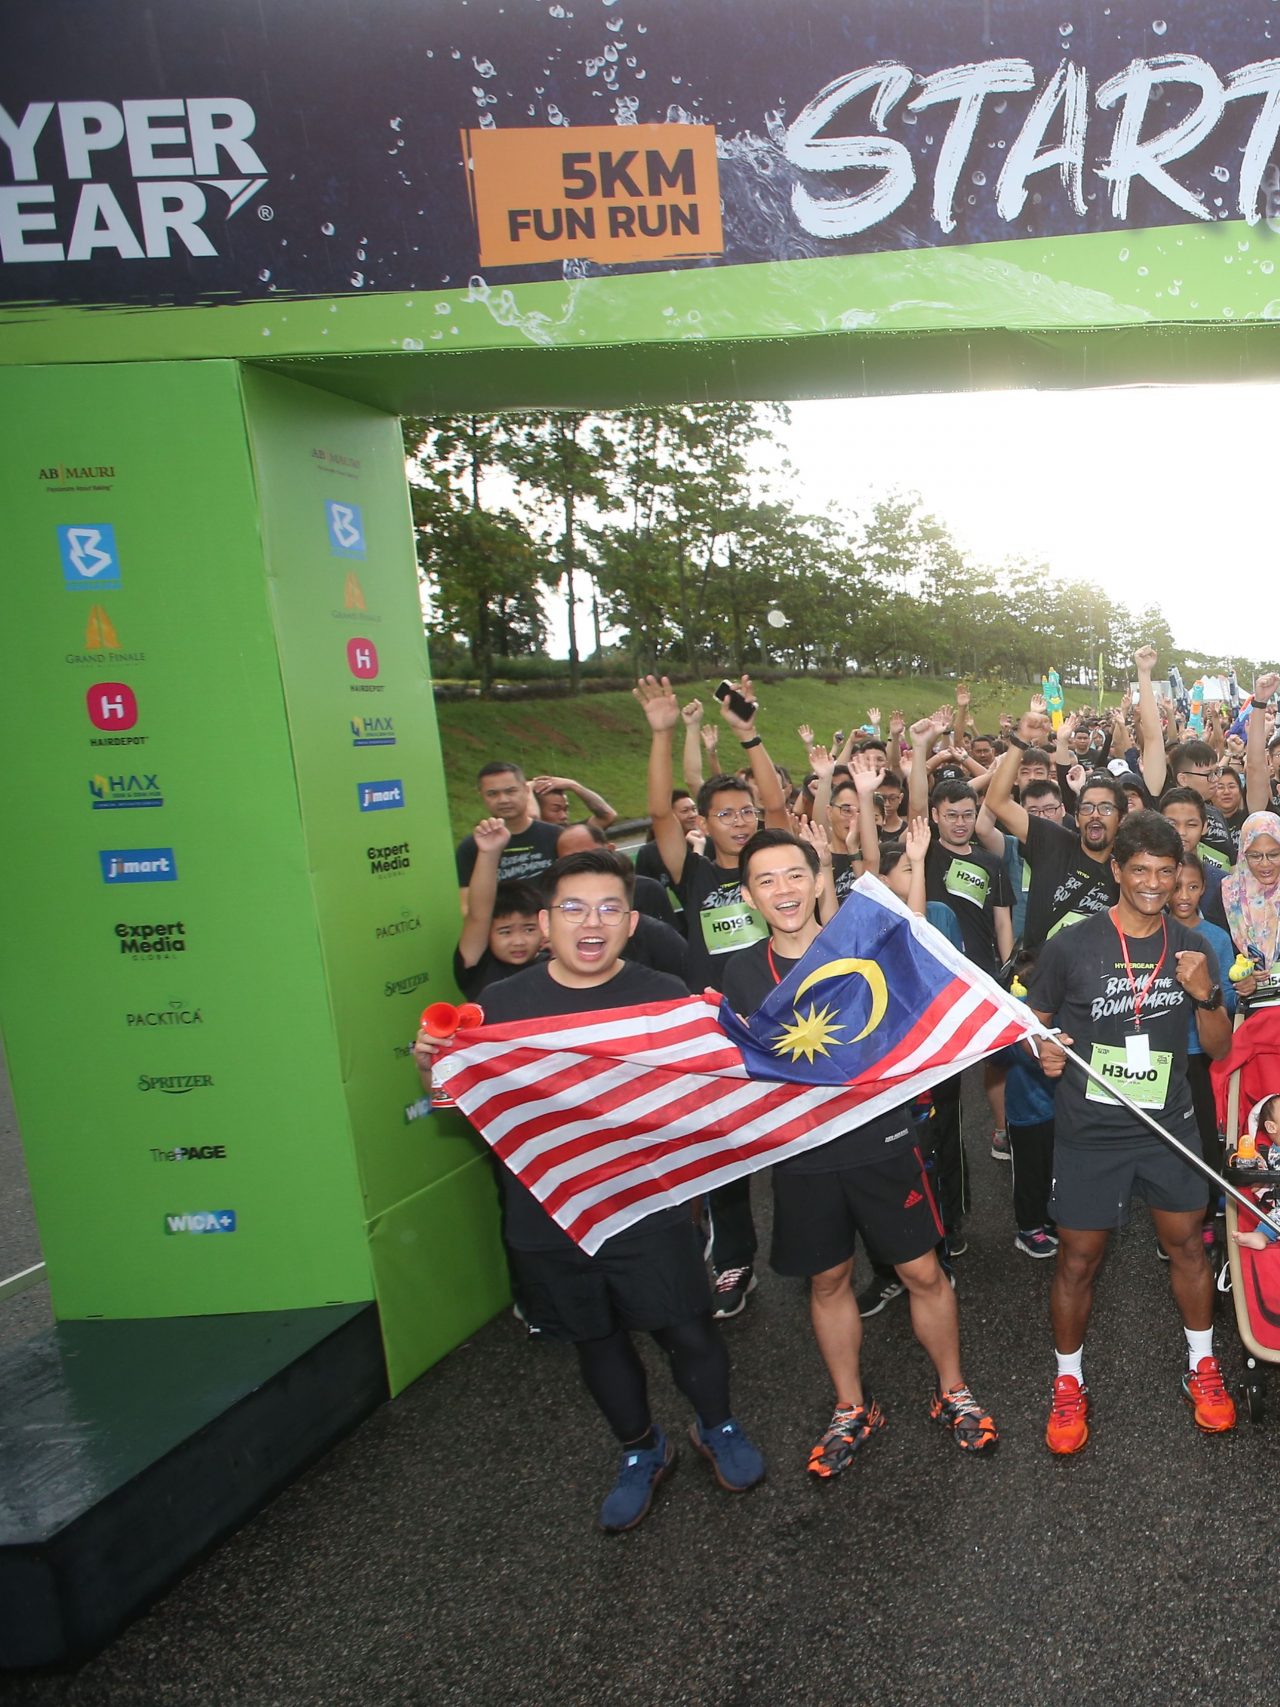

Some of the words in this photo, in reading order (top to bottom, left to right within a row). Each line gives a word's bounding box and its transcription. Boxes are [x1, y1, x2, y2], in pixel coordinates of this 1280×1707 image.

[563, 149, 696, 200] 5KM
[508, 207, 595, 242] FUN
[609, 203, 699, 238] RUN
[371, 856, 410, 874] Media
[120, 937, 185, 954] Media
[1153, 977, 1173, 990] THE
[126, 1009, 203, 1027] PACKTICA
